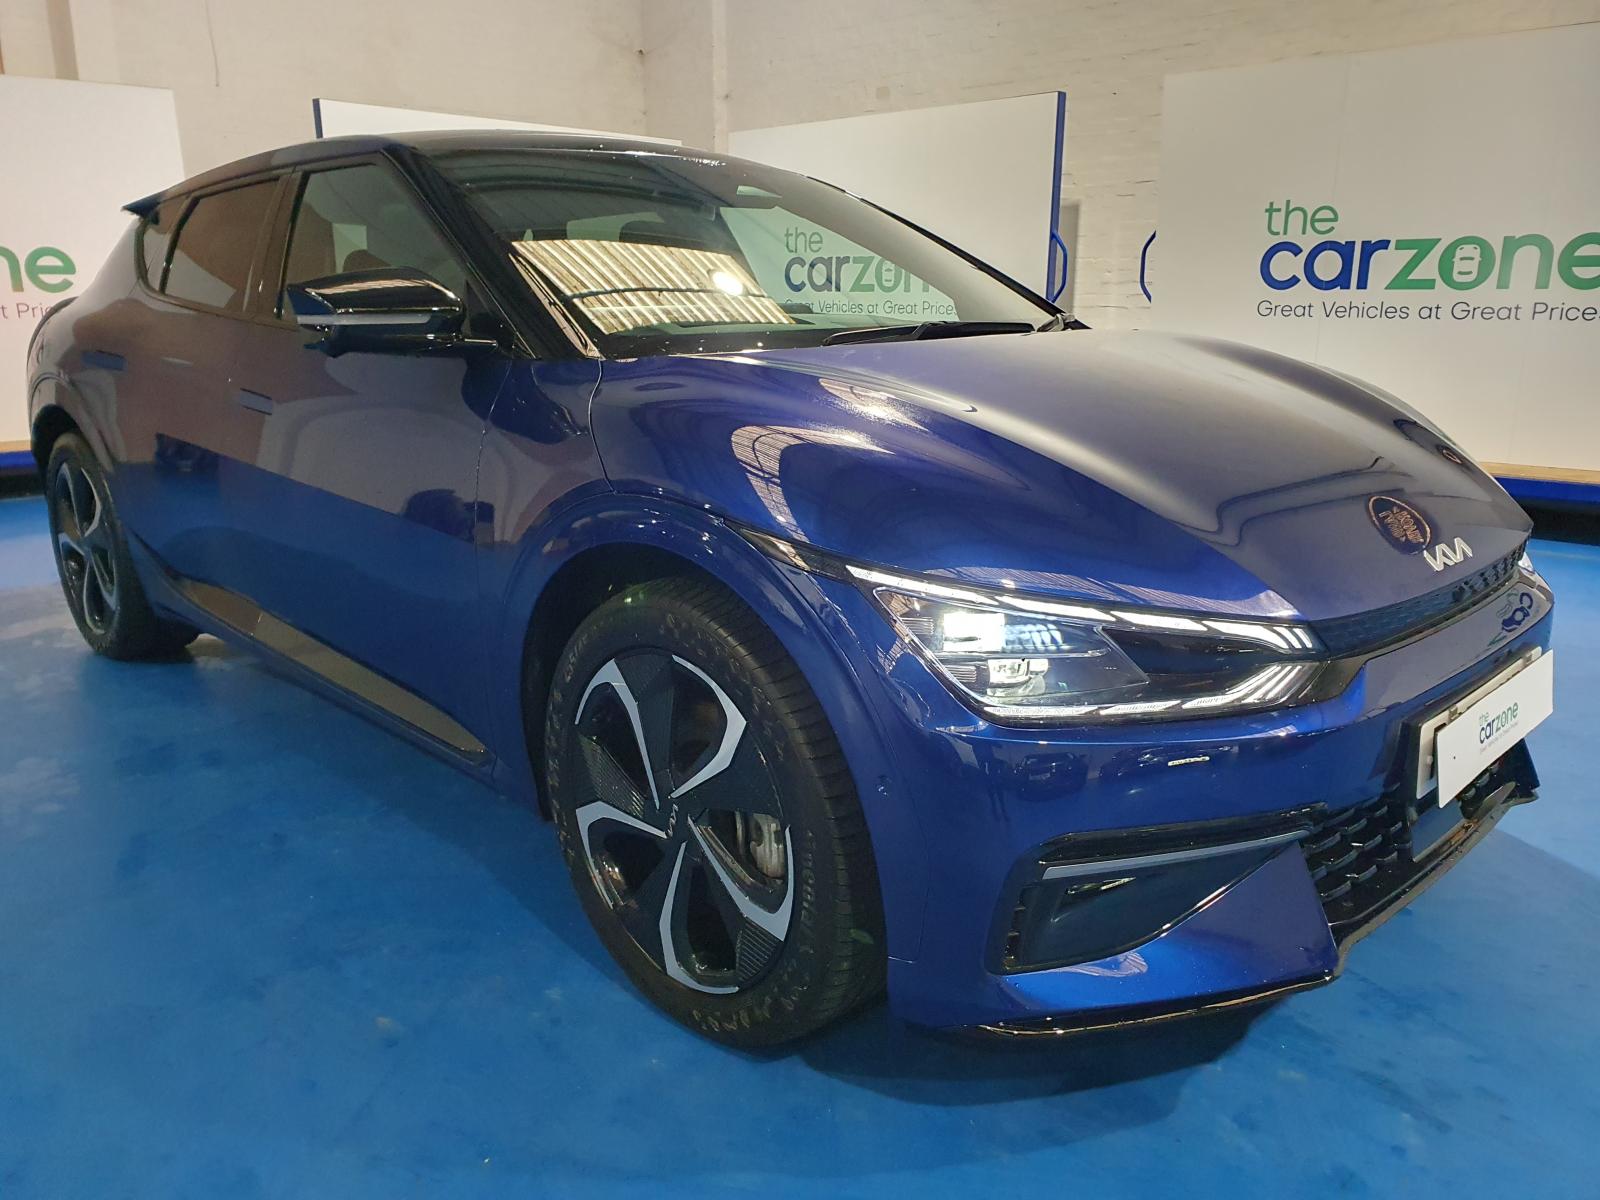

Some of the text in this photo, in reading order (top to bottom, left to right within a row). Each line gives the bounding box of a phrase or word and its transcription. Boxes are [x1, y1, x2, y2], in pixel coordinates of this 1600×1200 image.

[1264, 200, 1339, 235] the
[784, 227, 823, 253] the
[785, 256, 929, 293] carzo
[1259, 232, 1600, 290] carzone
[819, 299, 863, 313] Vehicles
[867, 303, 878, 314] at
[883, 300, 918, 315] Great
[1257, 300, 1600, 321] Great Vehicles at Great Price
[1479, 702, 1519, 744] carzone
